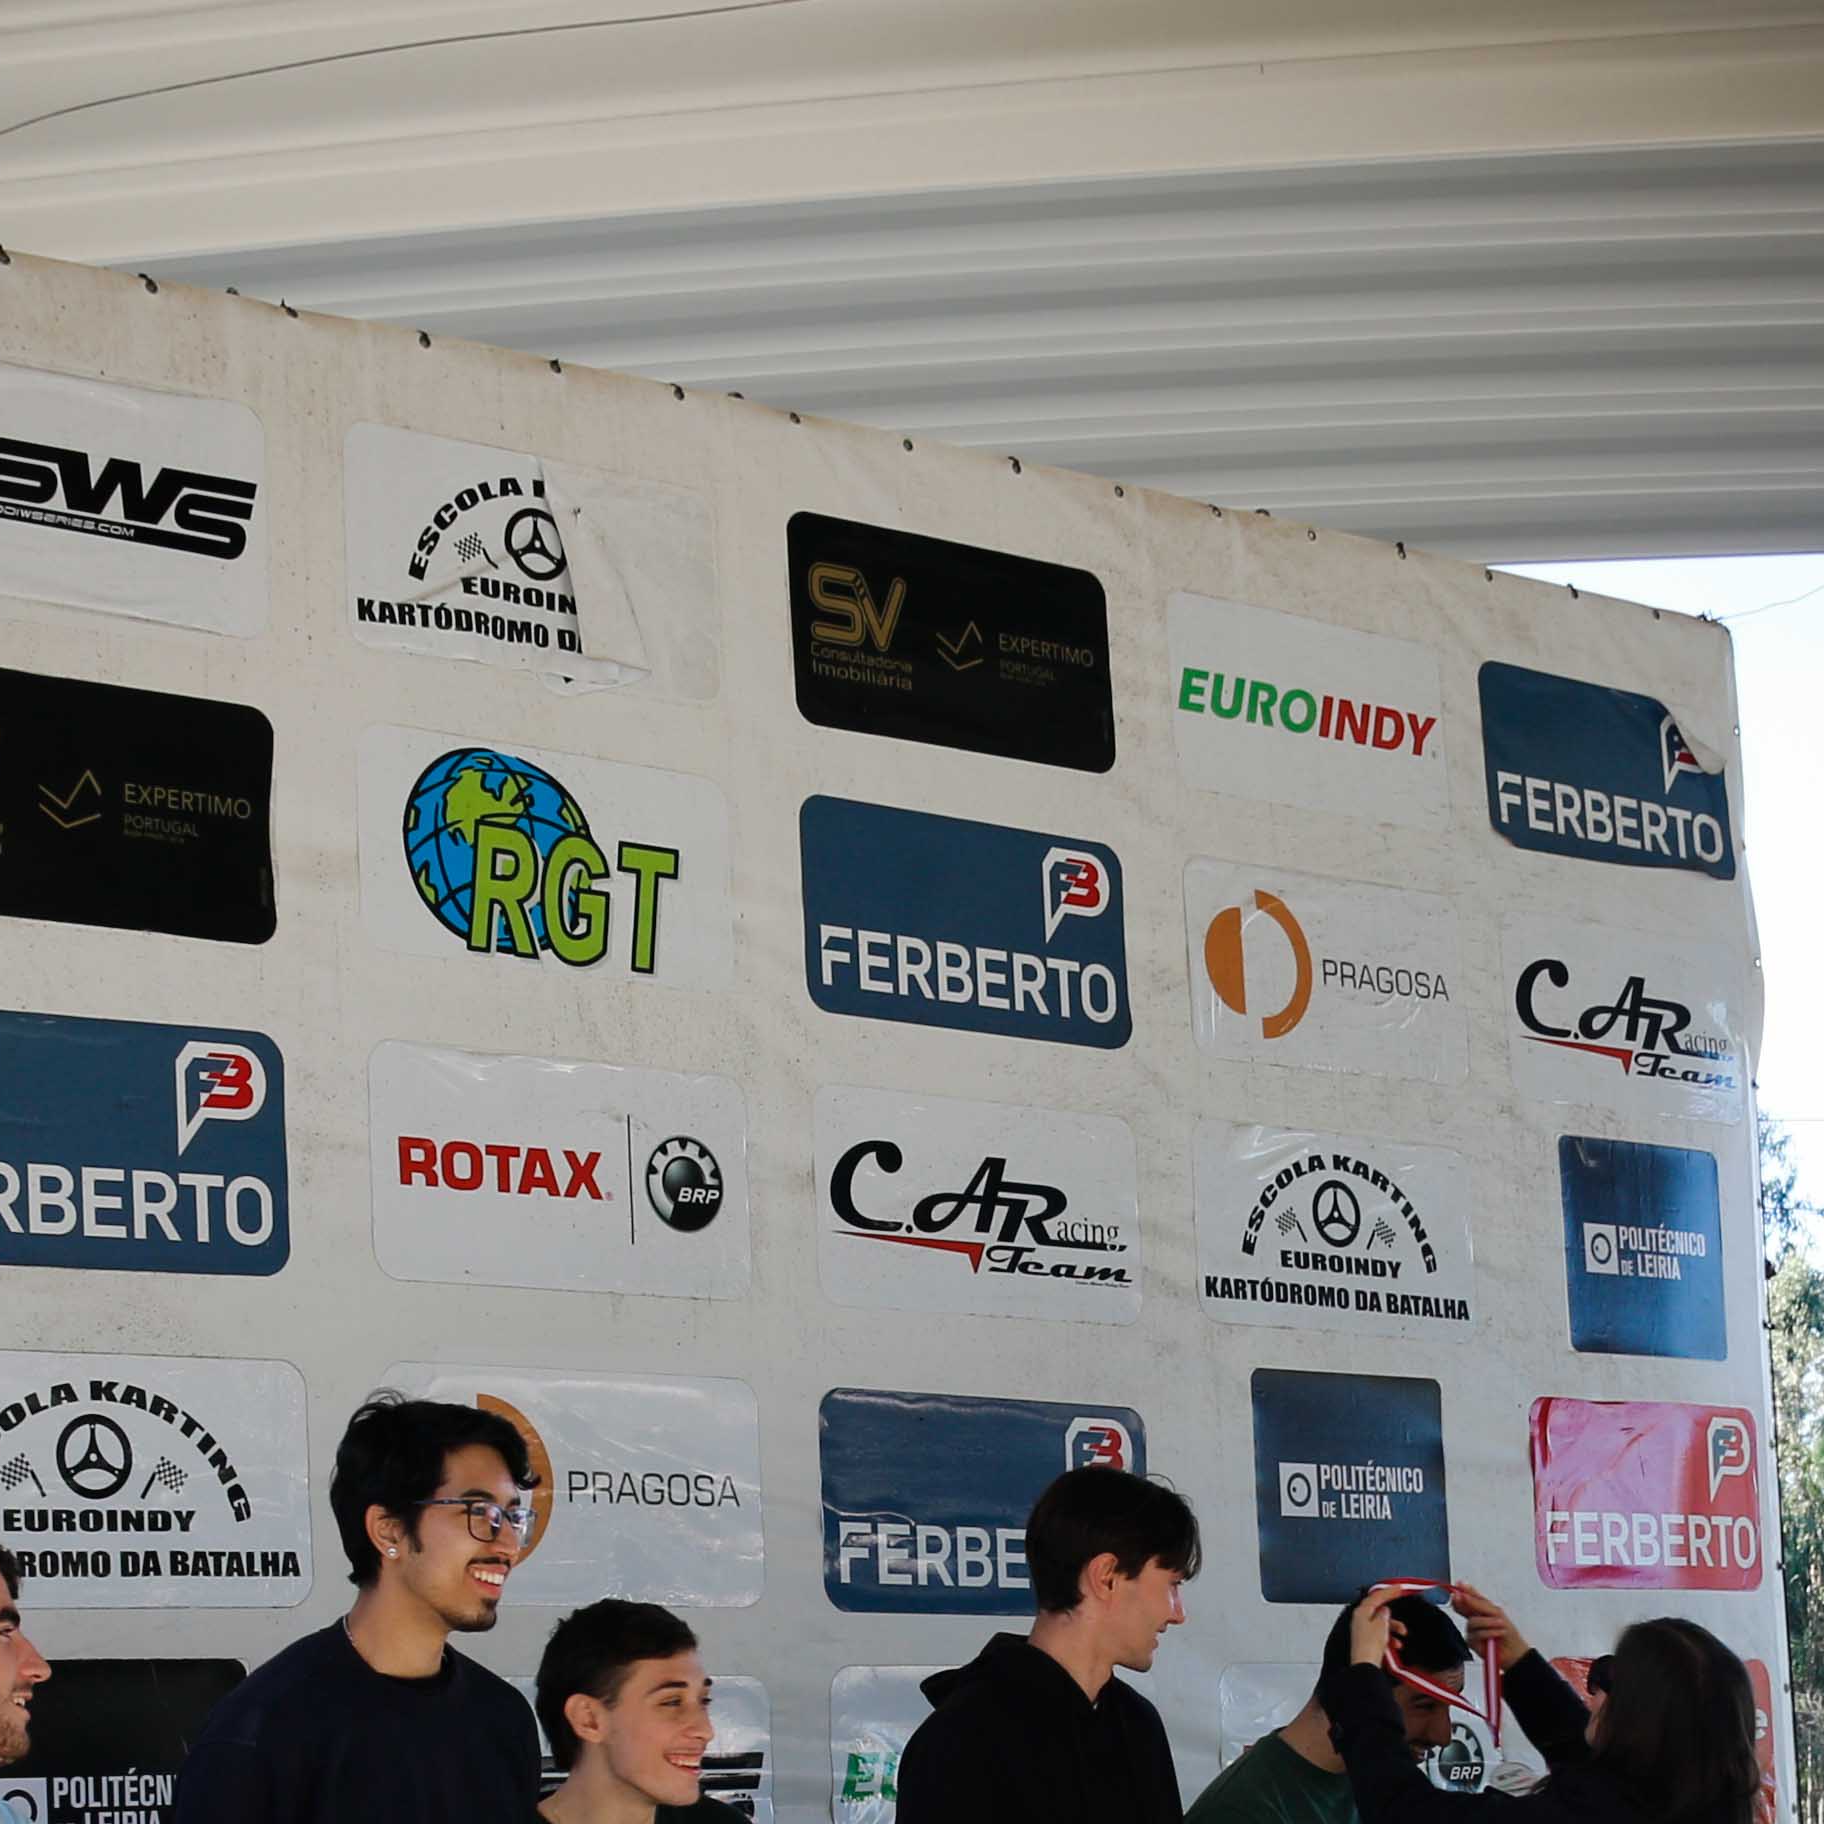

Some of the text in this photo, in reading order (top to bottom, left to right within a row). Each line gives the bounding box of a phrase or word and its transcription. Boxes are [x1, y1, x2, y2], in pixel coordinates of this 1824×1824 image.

[408, 477, 523, 581] ESCOLA
[461, 575, 577, 616] EUROIN
[808, 562, 907, 652] SV
[357, 597, 550, 649] KARTÓDROMO
[999, 633, 1095, 668] EXPERTIMO
[1178, 667, 1437, 756] EUROINDY
[124, 783, 251, 820] EXPERTIMO
[1497, 770, 1725, 863] FERBERTO
[123, 814, 200, 838] PORTUGAL
[467, 817, 679, 974] RGT
[820, 924, 1116, 1025] FERBERTO
[1322, 958, 1450, 1002] PRAGOSA
[398, 1136, 604, 1201] ROTAX
[678, 1186, 720, 1206] BRP
[1242, 1154, 1438, 1274] ESCOLA KARTING
[1618, 1221, 1706, 1258] POLITÉCNICO
[985, 1245, 1133, 1283] Team
[1280, 1250, 1402, 1279] EUROINDY
[1621, 1253, 1682, 1281] DE LEIRIA
[1204, 1276, 1470, 1321] KARTÓDROMO DA BATALHA
[89, 1379, 252, 1523] KARTING
[567, 1470, 741, 1508] PRAGOSA
[1320, 1460, 1424, 1494] POLITÉCNICO
[3, 1508, 196, 1532] EUROINDY
[1322, 1493, 1393, 1521] DE LEIRIA
[838, 1520, 1032, 1590] FERBE
[1546, 1510, 1757, 1570] FERBERTO
[119, 1550, 162, 1577] DA
[170, 1550, 301, 1578] BATALHA
[53, 1767, 177, 1811] POLITÉCN
[1449, 1766, 1482, 1781] BRP
